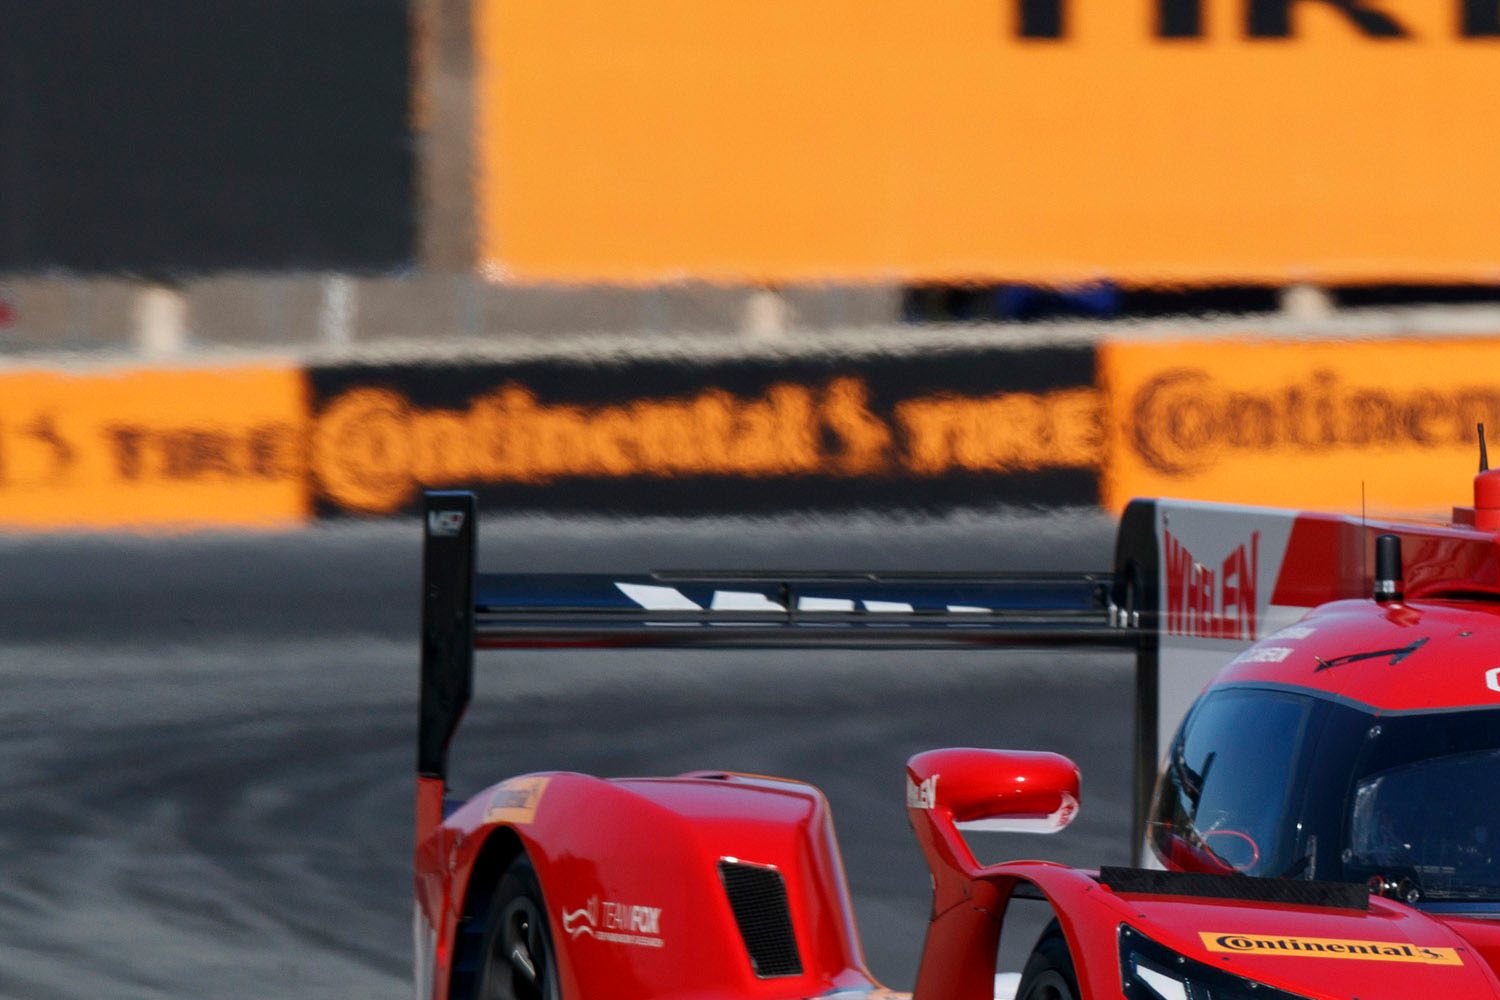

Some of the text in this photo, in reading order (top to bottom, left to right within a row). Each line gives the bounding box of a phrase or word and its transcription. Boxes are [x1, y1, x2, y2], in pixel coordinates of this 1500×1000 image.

[312, 382, 1098, 514] Continental TIRE
[1163, 528, 1260, 641] WHELEN
[1216, 935, 1416, 956] Continental
